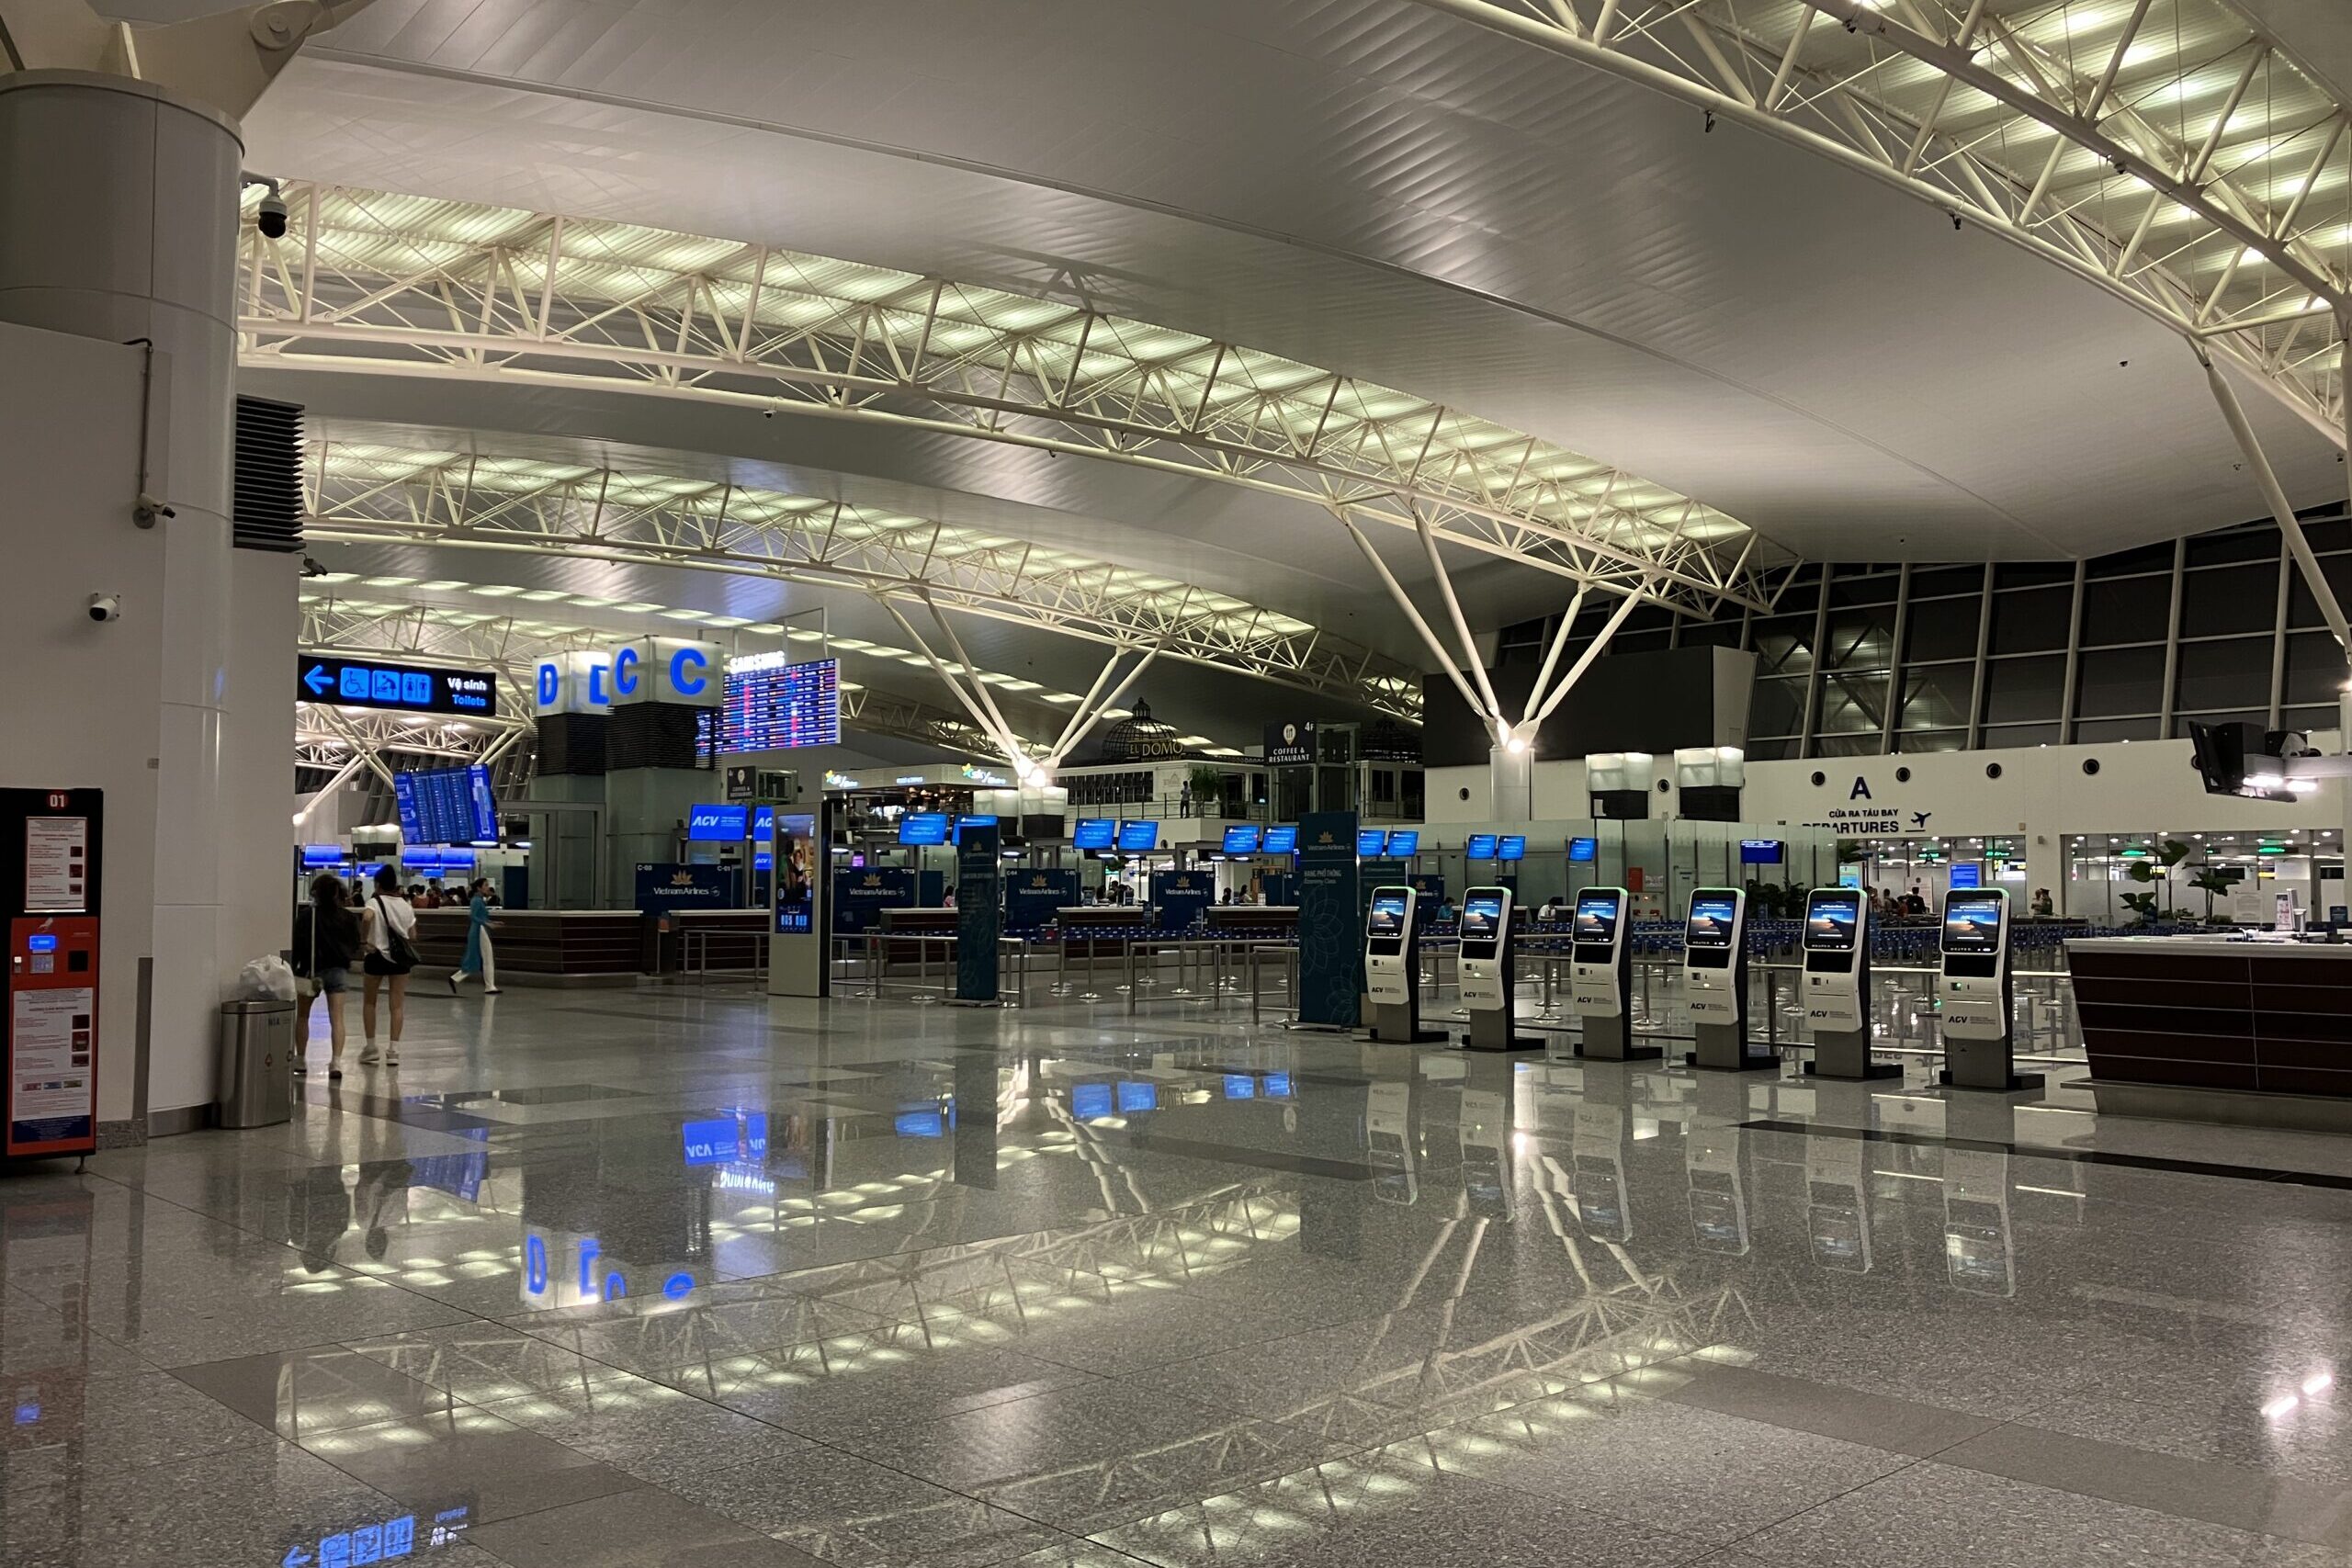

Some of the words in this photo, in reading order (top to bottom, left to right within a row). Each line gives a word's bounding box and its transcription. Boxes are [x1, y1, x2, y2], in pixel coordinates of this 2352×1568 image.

[615, 649, 638, 694] C
[670, 649, 706, 695] C
[447, 677, 462, 690] Vệ
[463, 679, 487, 691] sinh
[539, 664, 558, 705] D
[452, 694, 486, 706] Toilets
[1304, 721, 1314, 731] 4F
[1130, 744, 1139, 754] EL
[1142, 742, 1183, 756] DOMO
[1269, 754, 1309, 762] RESTAURANT
[1849, 776, 1871, 800] A
[50, 794, 65, 807] 01
[1848, 809, 1860, 818] RA
[1881, 808, 1899, 817] BAY
[693, 816, 718, 827] ACV
[756, 817, 772, 827] AC
[1802, 821, 1899, 833] ARTURES
